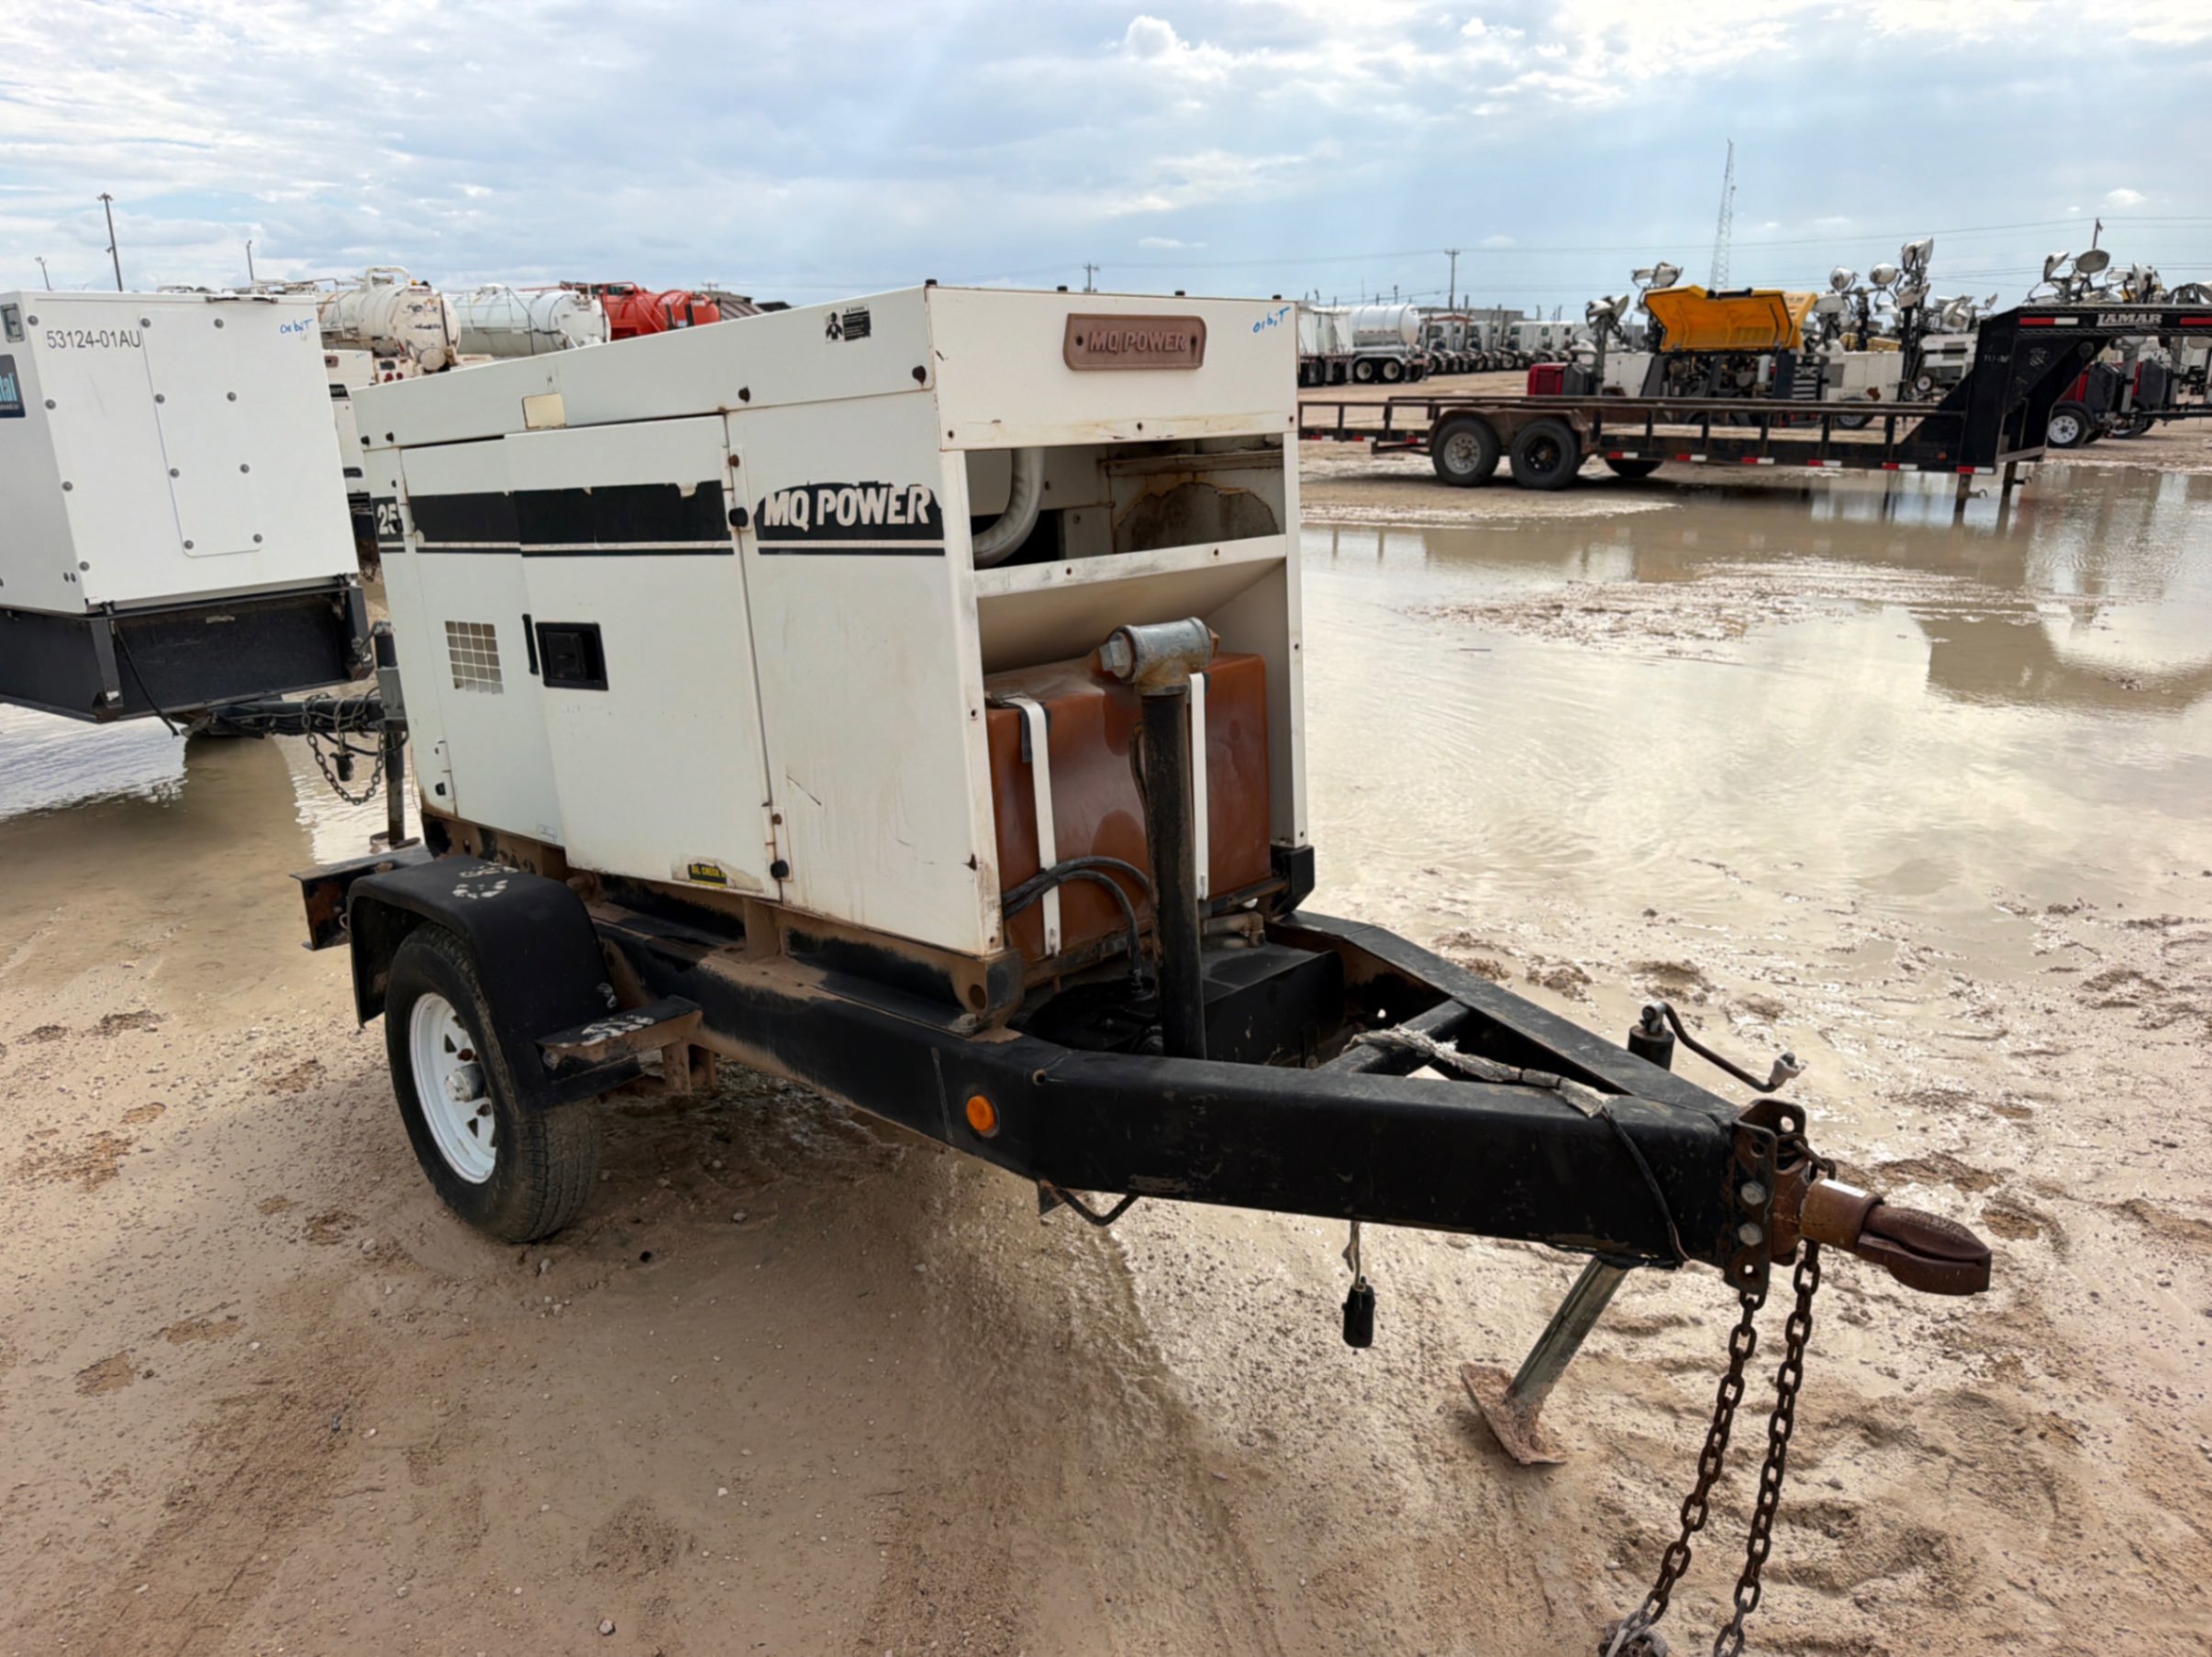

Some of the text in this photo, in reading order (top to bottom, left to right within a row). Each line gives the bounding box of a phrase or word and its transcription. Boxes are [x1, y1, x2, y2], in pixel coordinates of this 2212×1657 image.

[2095, 313, 2163, 328] LAMAR
[46, 329, 141, 349] 53124-01AU
[1088, 330, 1188, 355] MQ POWER
[377, 504, 398, 535] 25
[763, 485, 932, 532] MQ POWER
